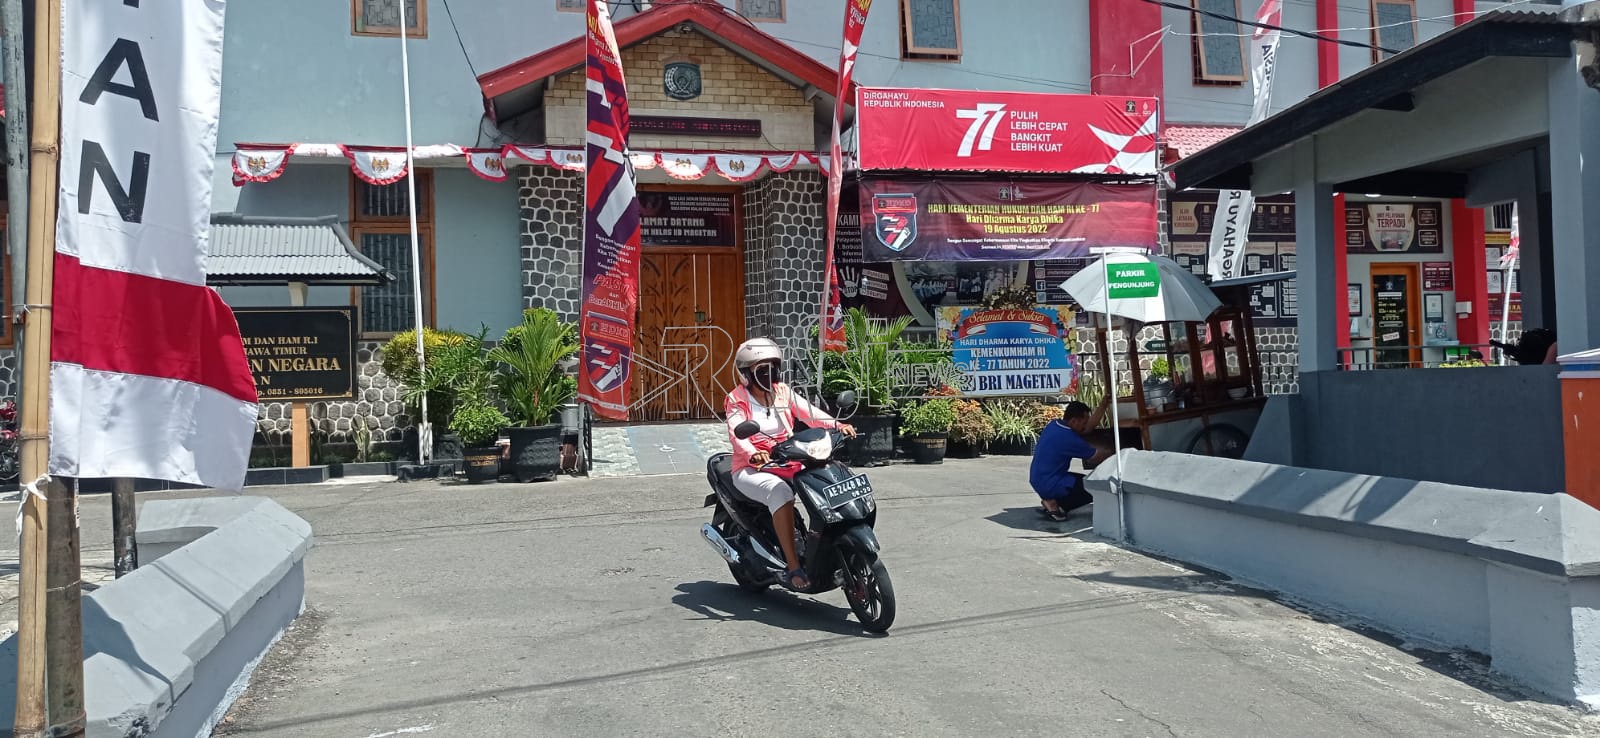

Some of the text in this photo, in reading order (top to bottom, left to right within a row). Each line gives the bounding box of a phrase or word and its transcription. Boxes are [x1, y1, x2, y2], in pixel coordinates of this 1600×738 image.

[863, 92, 909, 100] DIRGAHAYU
[863, 100, 945, 109] REPUBLIK INDONESIA
[78, 0, 160, 225] AN
[1010, 111, 1038, 120] PULIH
[956, 103, 1007, 157] 77
[1010, 122, 1068, 131] LEBIH CEPAT
[1010, 133, 1052, 142] BANGKIT
[1010, 143, 1063, 152] LEBIH KUAT
[928, 204, 946, 213] HARI
[948, 204, 1001, 214] KEMENTERIAN
[1001, 204, 1030, 214] HUKUM
[1031, 205, 1047, 214] DAN
[1047, 205, 1065, 214] HAM
[1091, 204, 1099, 213] 77
[670, 217, 704, 226] DATANG
[837, 214, 859, 226] KAMI
[966, 214, 1063, 225] Hari Dharma Karya Dhika
[1377, 218, 1406, 228] TERPADU
[651, 228, 672, 236] KELAS
[683, 229, 717, 237] MAGETAN
[984, 225, 1048, 235] 19 Agustus 2022
[1115, 270, 1145, 278] PARKIR
[1108, 281, 1155, 289] PENGUNJUNG
[968, 310, 1045, 324] Selamat & Sukses
[254, 336, 275, 345] DAN
[277, 336, 301, 345] HAM
[303, 336, 318, 345] R.I
[960, 338, 977, 346] HARI
[1010, 337, 1033, 345] KARYA
[273, 346, 308, 355] TIMUR
[971, 346, 1046, 358] KEMENKUMHAM RI
[268, 357, 342, 372] NEGARA
[969, 360, 980, 370] KE
[987, 359, 996, 370] 77
[998, 359, 1026, 370] TAHUN
[1027, 358, 1050, 369] 2022
[978, 373, 1061, 391] BRI MAGETAN
